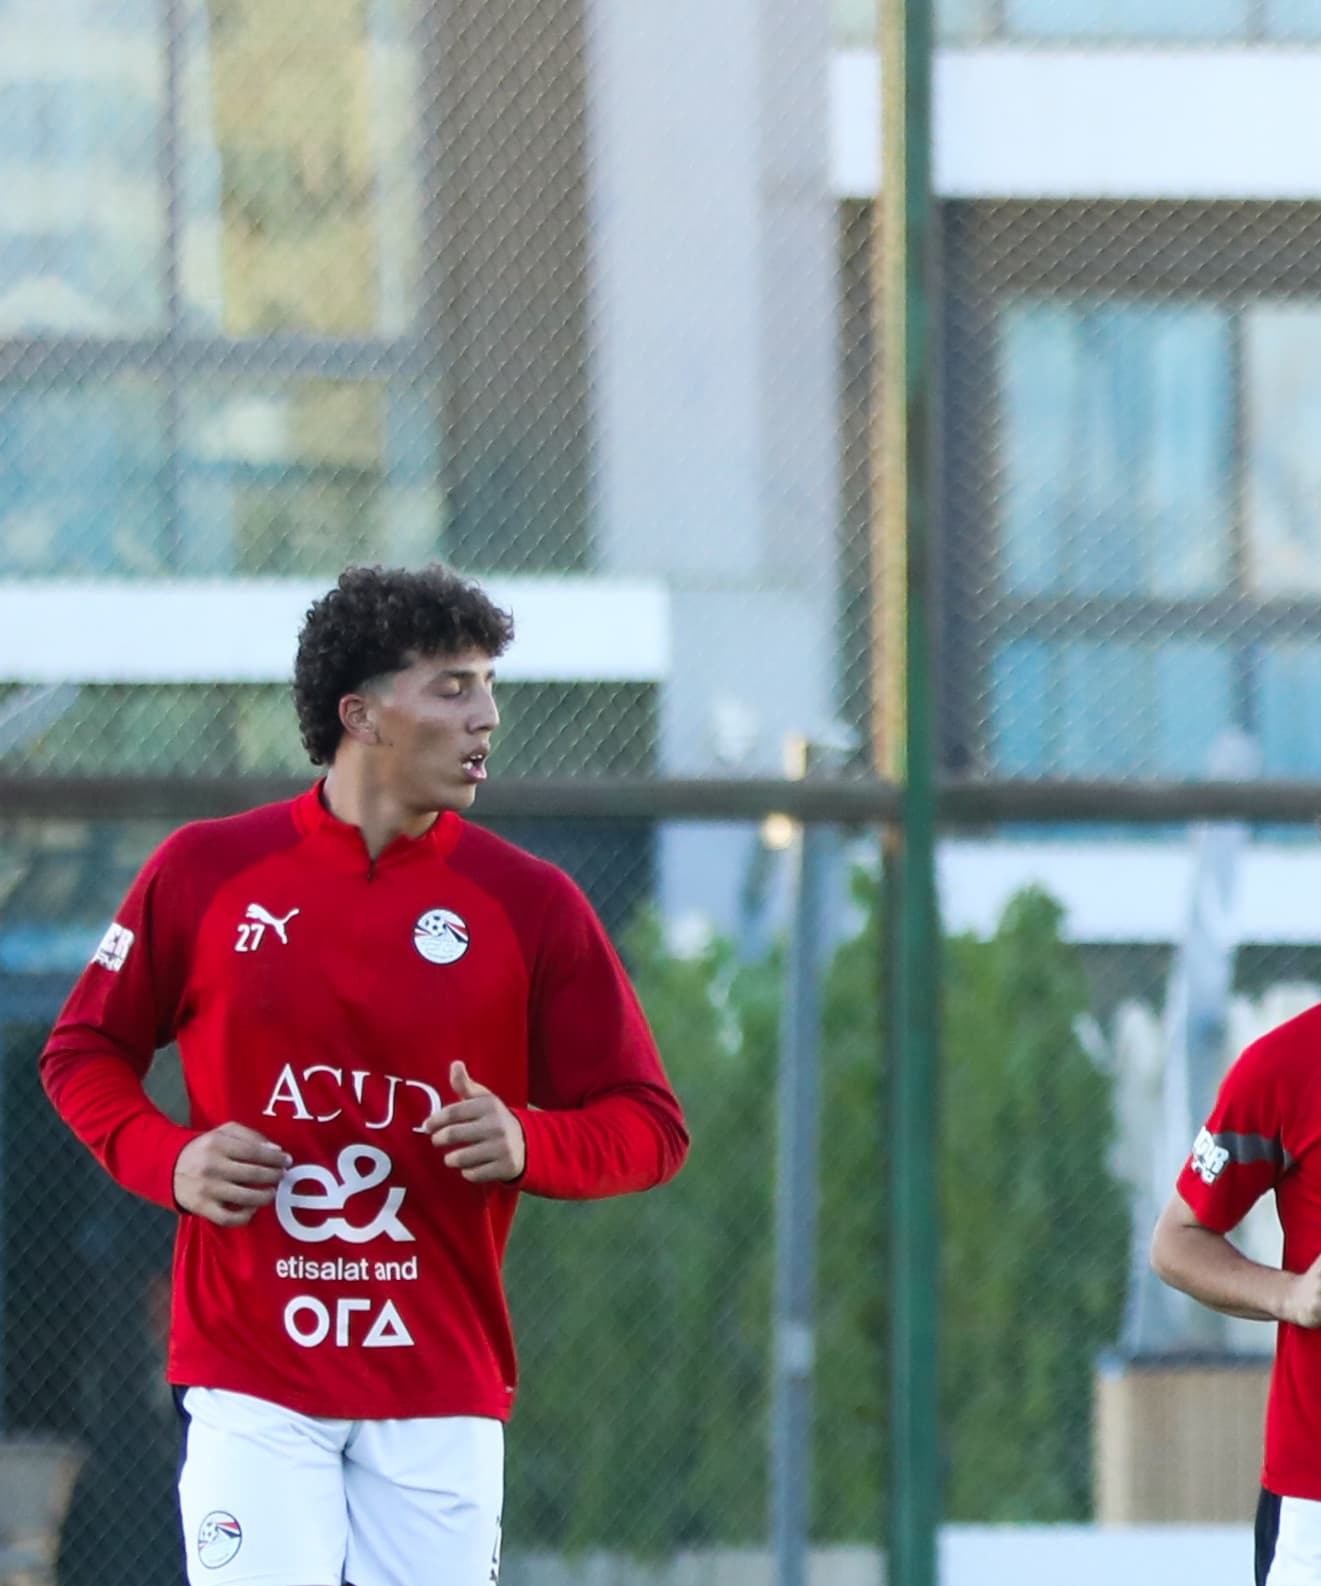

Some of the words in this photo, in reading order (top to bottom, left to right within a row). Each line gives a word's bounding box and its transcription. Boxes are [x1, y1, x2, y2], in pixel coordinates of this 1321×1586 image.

[235, 923, 266, 952] 27
[275, 1255, 370, 1281] etisalat
[374, 1255, 418, 1281] and
